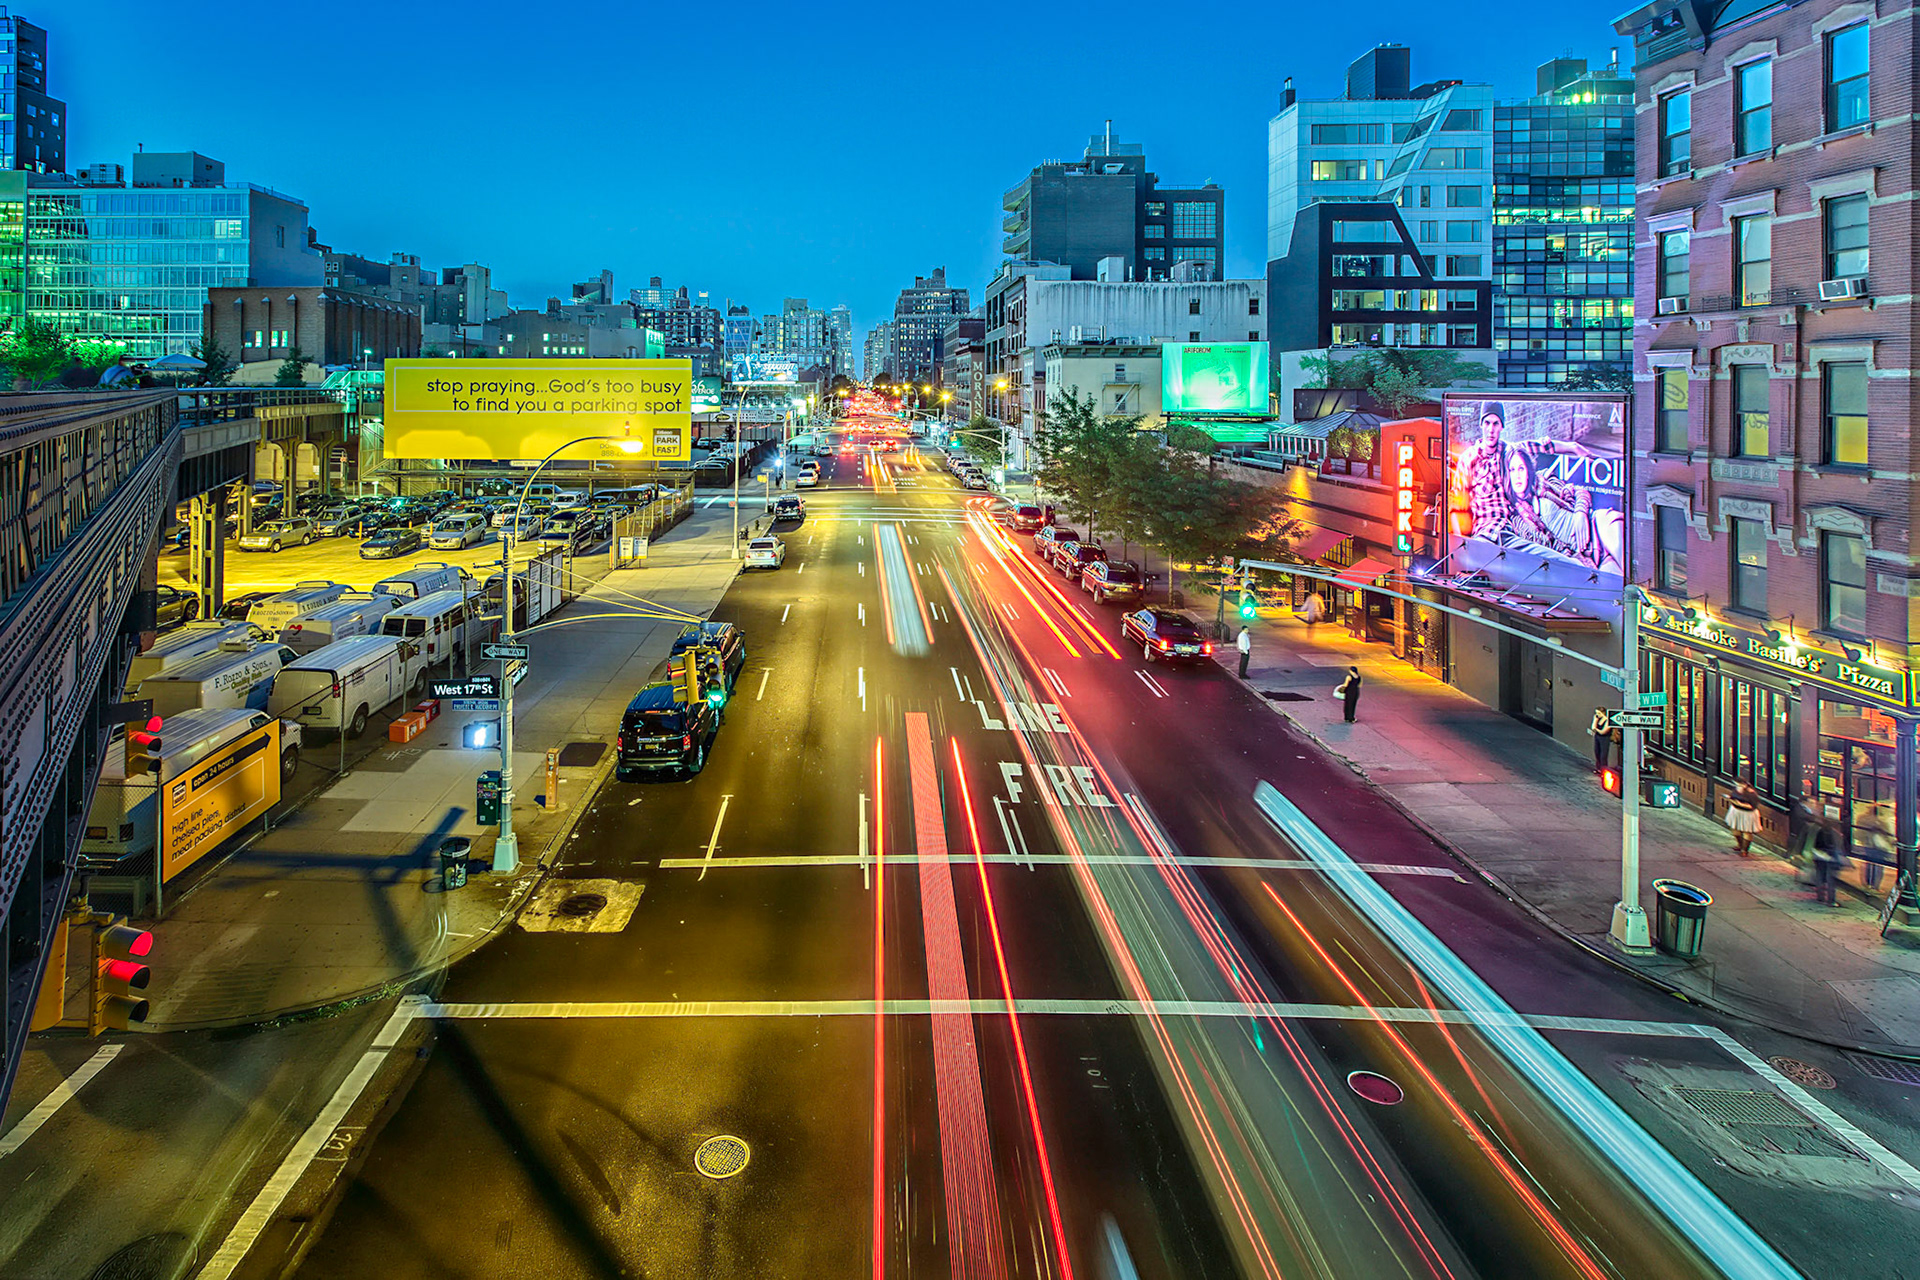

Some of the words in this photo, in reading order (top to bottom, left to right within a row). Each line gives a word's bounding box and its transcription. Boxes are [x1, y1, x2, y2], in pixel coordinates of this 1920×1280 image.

[427, 378, 463, 395] stop
[606, 379, 634, 393] too
[641, 379, 682, 396] busy
[972, 361, 983, 418] MORANS
[453, 397, 470, 411] to
[476, 397, 509, 411] find
[515, 400, 546, 414] you
[553, 400, 564, 411] a
[571, 398, 638, 415] parking
[644, 398, 682, 415] spot
[1543, 453, 1625, 488] AVICII
[1398, 445, 1413, 532] PARK
[1664, 615, 1738, 648] Artichoke
[1836, 662, 1894, 695] Pizza
[223, 671, 243, 686] Rozzo
[244, 665, 250, 676] &
[433, 684, 462, 696] West
[464, 684, 481, 695] 17th
[481, 683, 493, 695] St
[976, 700, 1071, 733] LANE
[193, 773, 208, 787] open
[208, 766, 218, 777] 24
[217, 757, 235, 774] hours
[998, 762, 1114, 807] FIRE
[171, 817, 189, 835] high
[190, 808, 204, 822] line
[171, 839, 193, 861] meat
[193, 818, 223, 847] packing
[224, 802, 247, 823] district
[171, 820, 200, 848] chelsea
